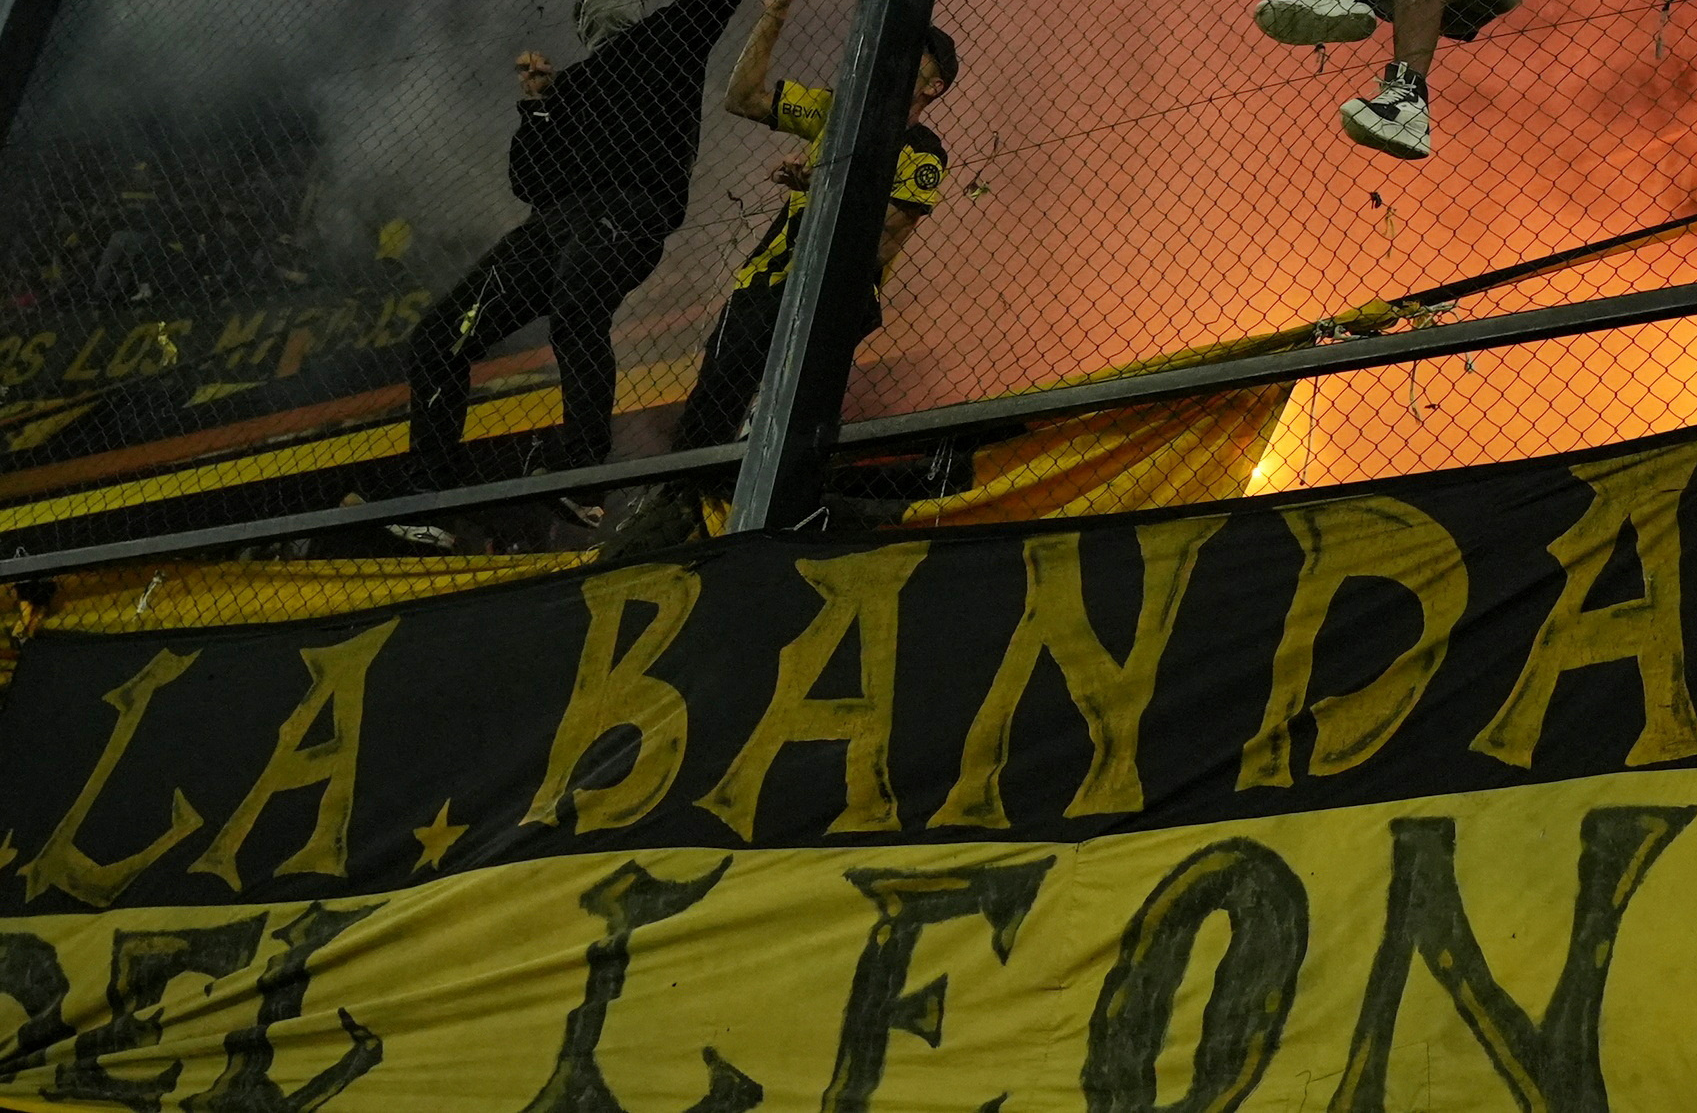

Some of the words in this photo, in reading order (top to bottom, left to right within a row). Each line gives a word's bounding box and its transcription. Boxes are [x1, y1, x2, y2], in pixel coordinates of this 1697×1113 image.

[782, 102, 822, 119] BBVA
[63, 319, 193, 381] LOS
[16, 616, 400, 907] LA
